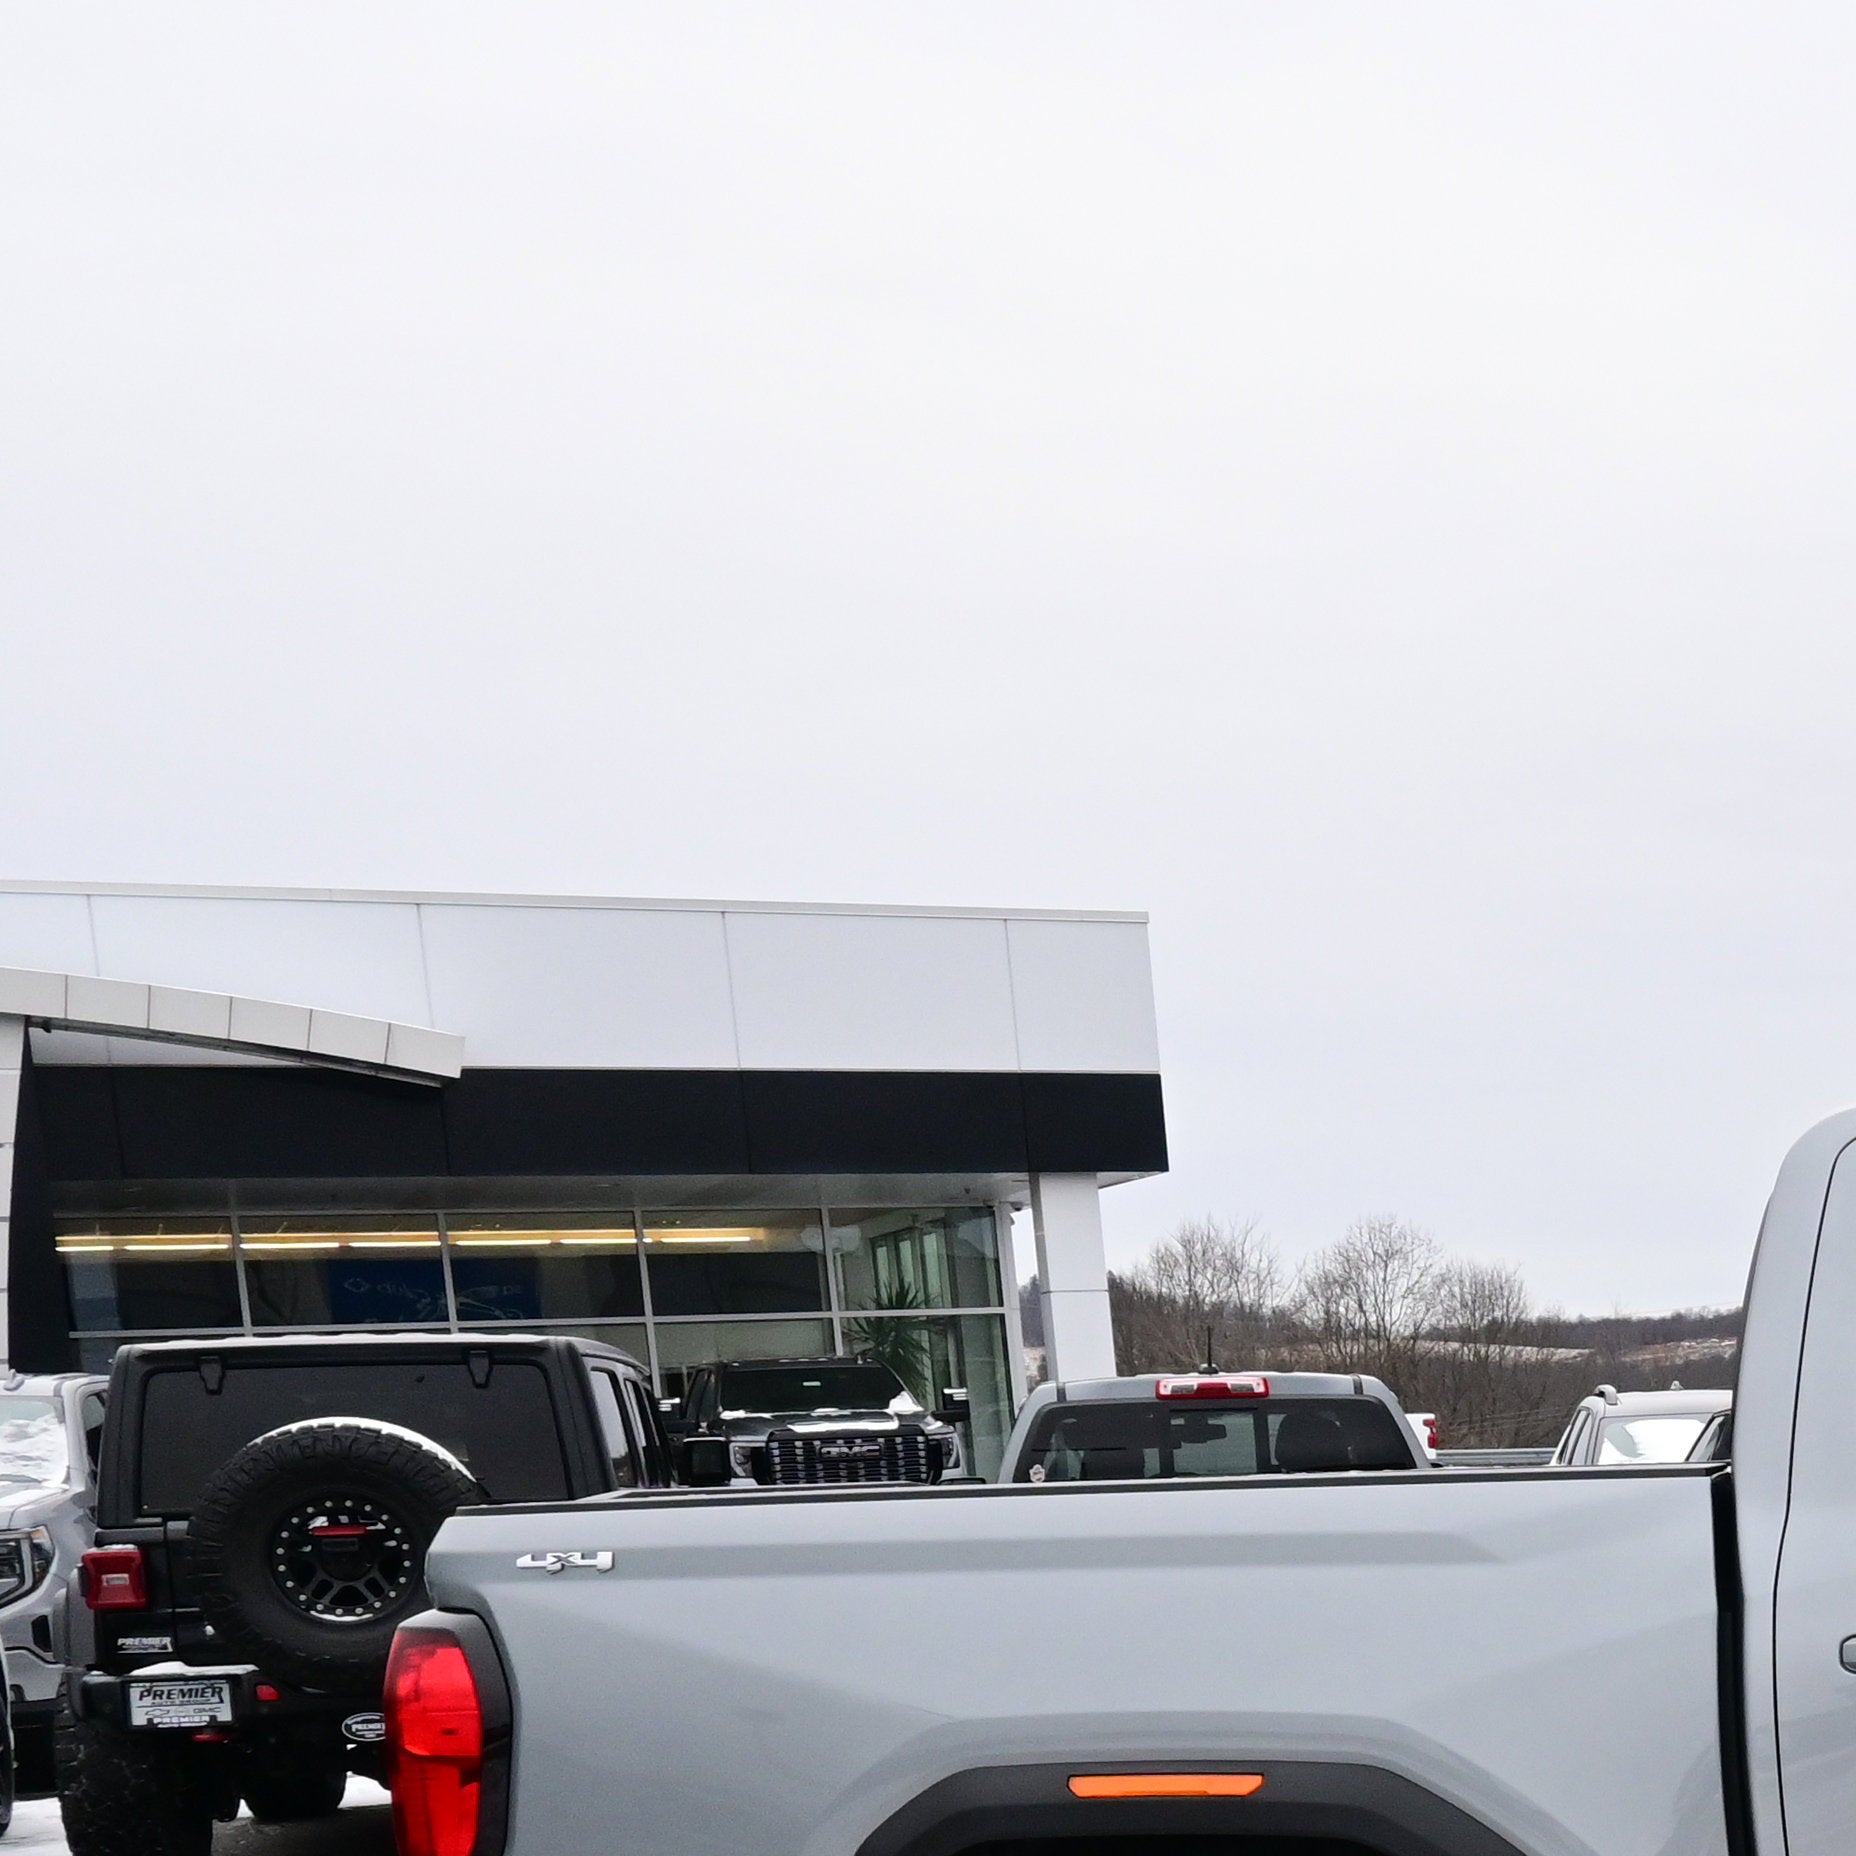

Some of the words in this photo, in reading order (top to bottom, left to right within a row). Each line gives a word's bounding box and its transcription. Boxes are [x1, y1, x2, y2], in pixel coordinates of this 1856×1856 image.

[821, 1445, 881, 1456] GMC
[516, 1551, 614, 1574] 4X4
[139, 1686, 225, 1703] PREMIER
